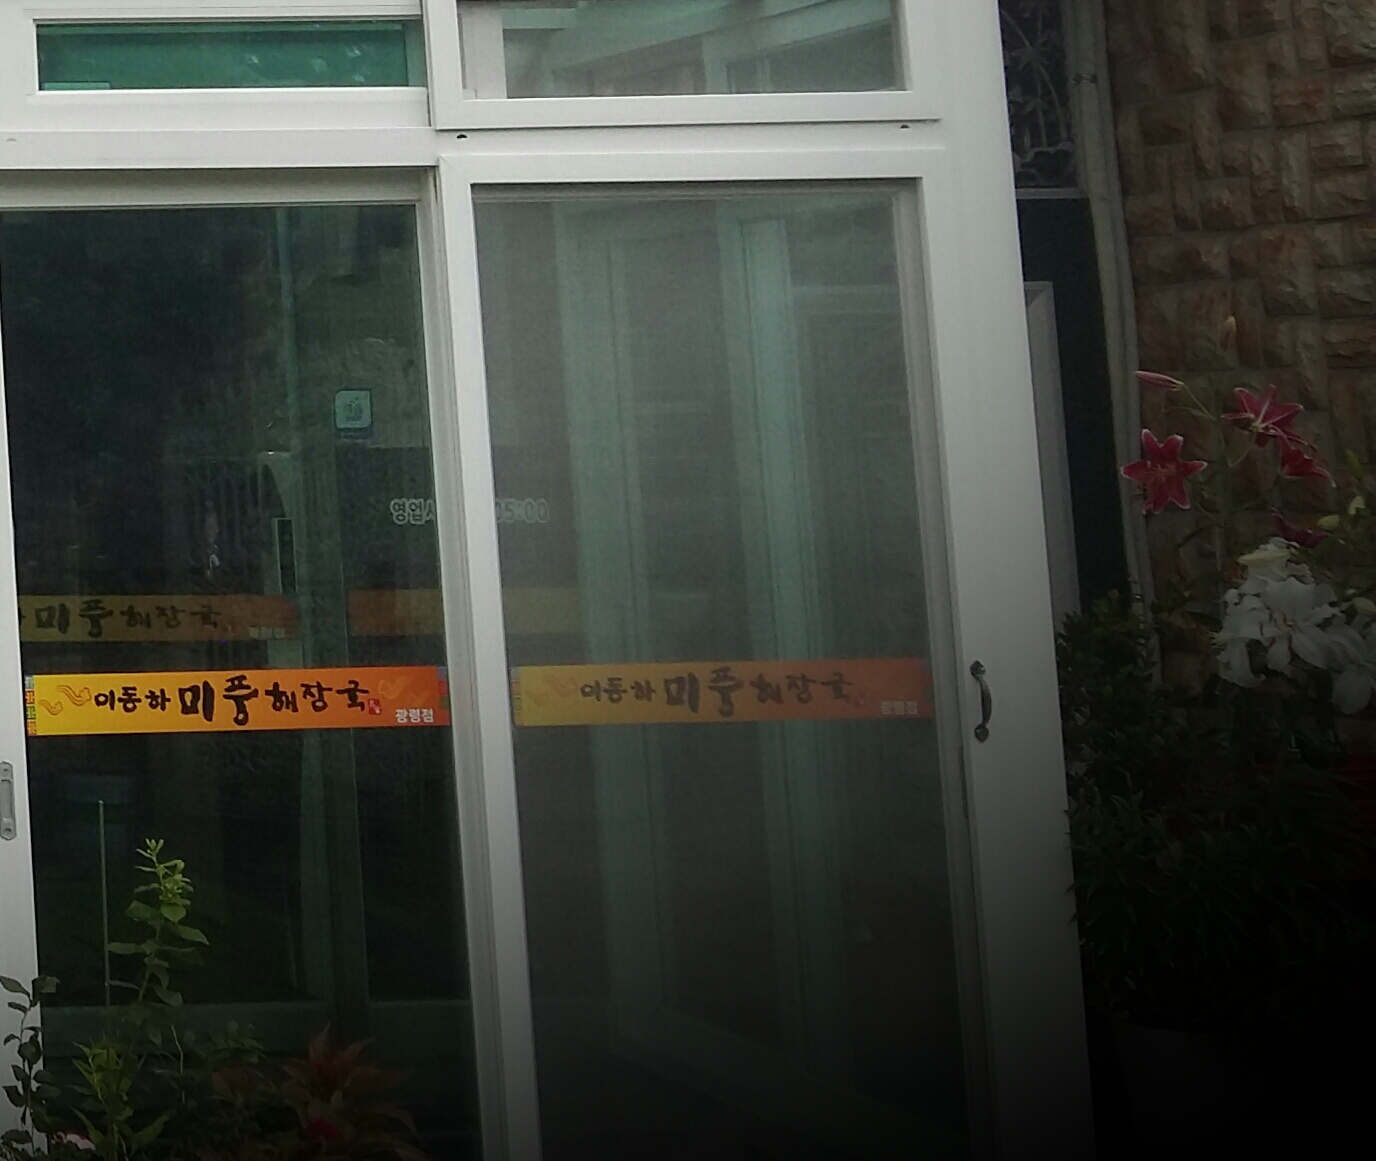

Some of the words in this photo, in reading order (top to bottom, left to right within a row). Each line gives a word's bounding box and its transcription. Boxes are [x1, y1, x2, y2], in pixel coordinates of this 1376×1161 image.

[94, 686, 171, 713] 이동하
[178, 675, 259, 726] 미풍
[265, 680, 370, 712] 해장국
[395, 708, 434, 723] 광령점
[580, 677, 656, 704] 이동하
[664, 666, 744, 718] 미풍
[750, 672, 854, 705] 해장국
